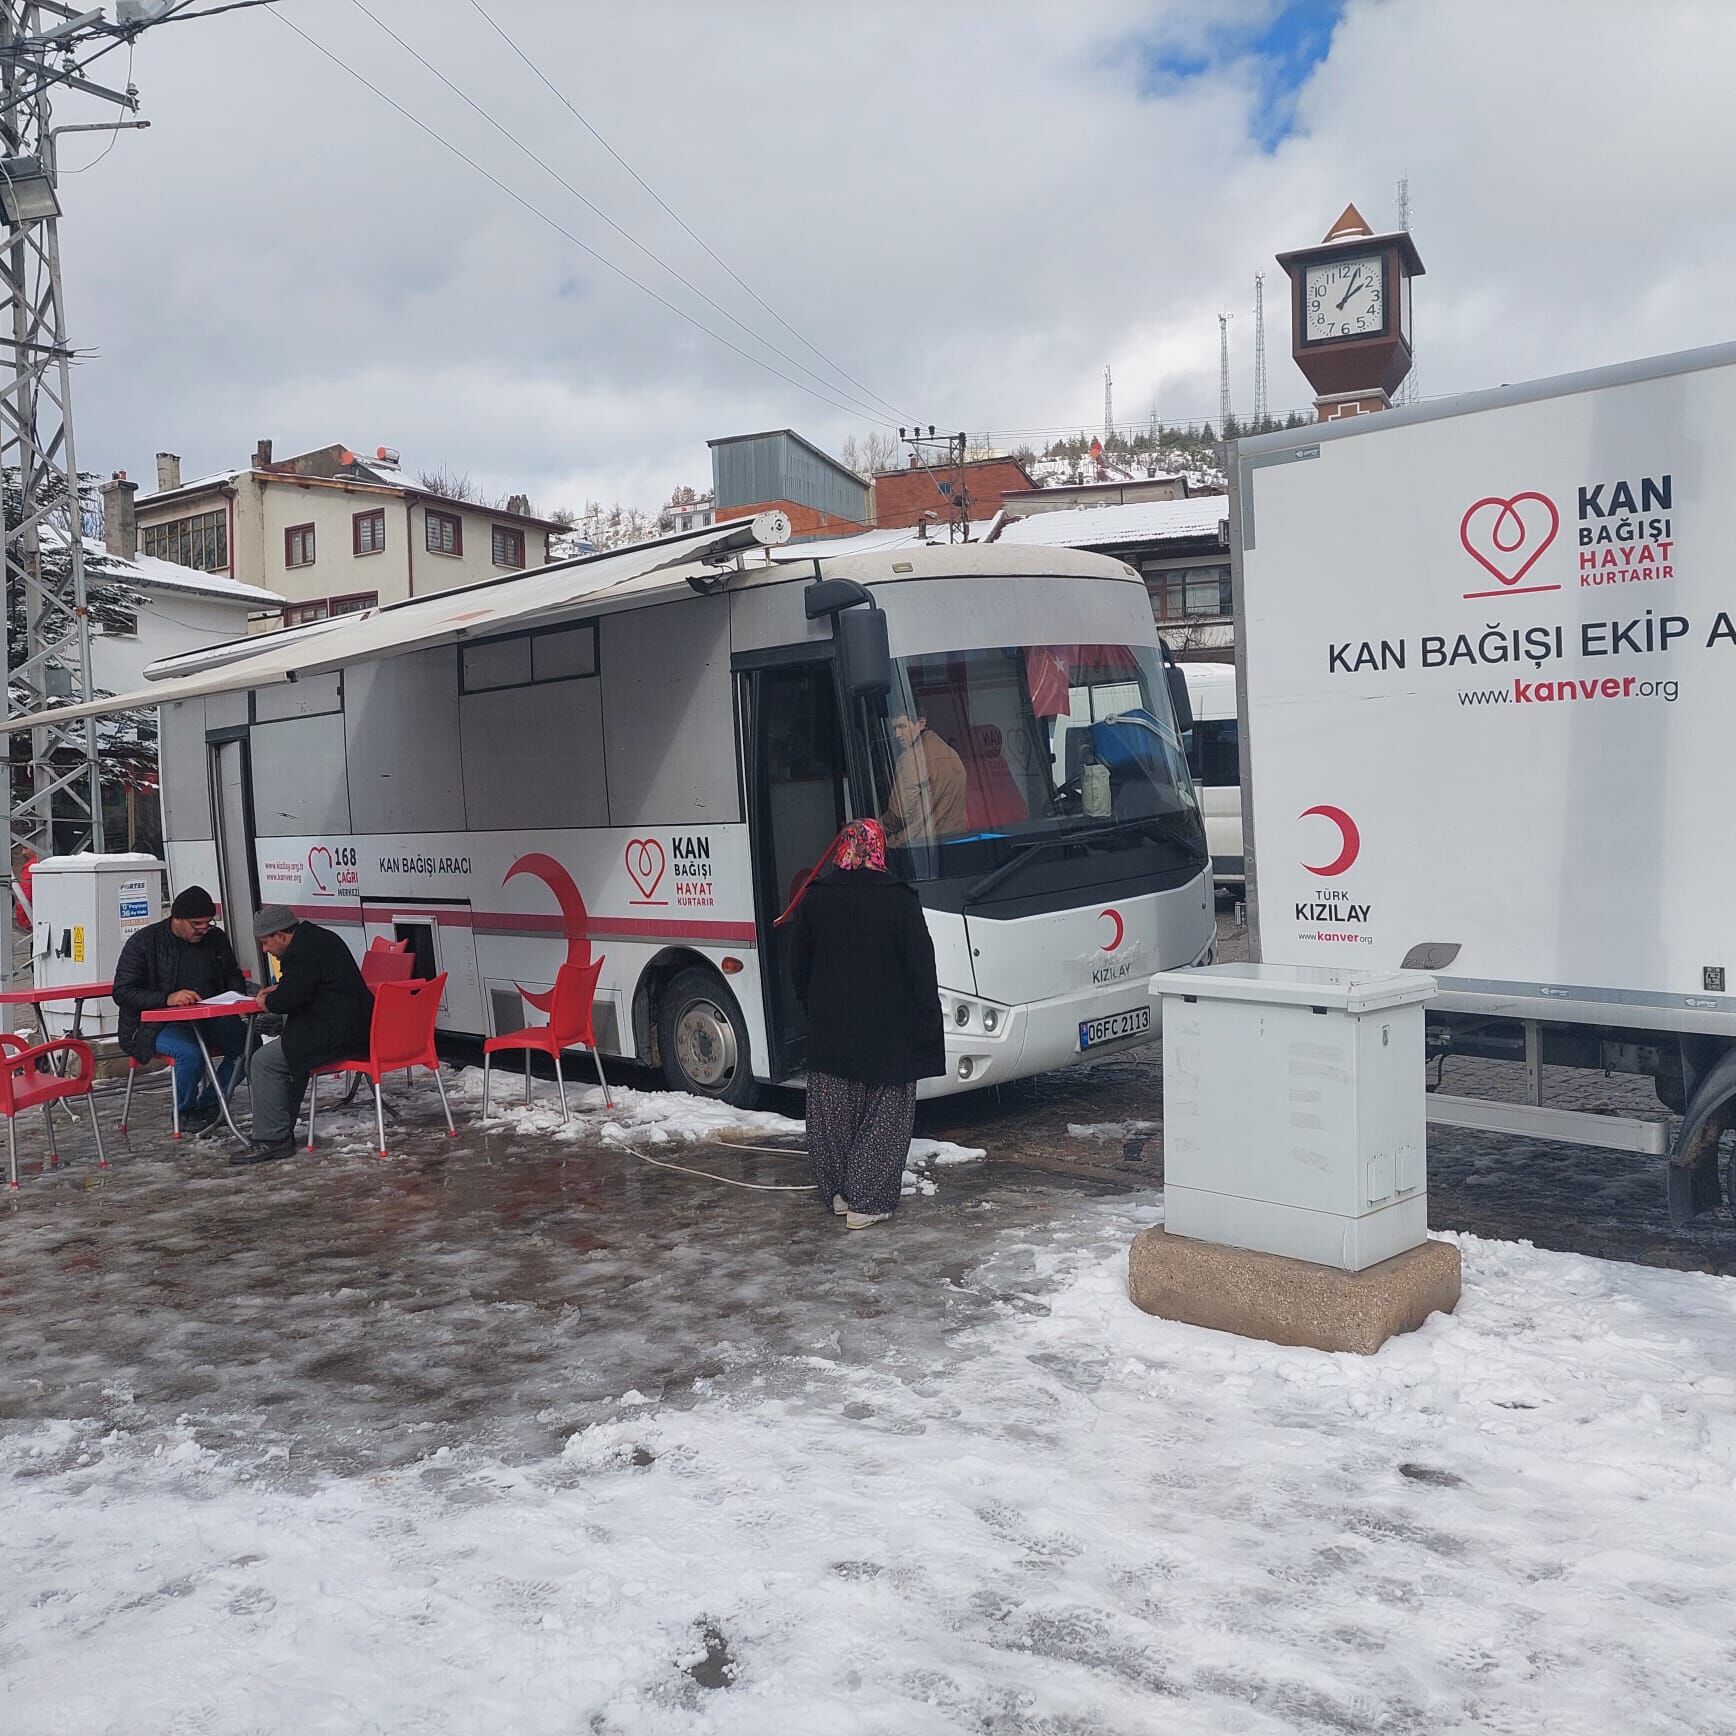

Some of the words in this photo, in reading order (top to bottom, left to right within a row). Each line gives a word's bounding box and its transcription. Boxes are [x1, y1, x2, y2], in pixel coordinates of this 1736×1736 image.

[1326, 272, 1335, 285] 11
[1339, 266, 1351, 279] 12
[1365, 276, 1374, 288] 2
[1314, 285, 1327, 298] 10
[1371, 290, 1380, 302] 3
[1311, 300, 1321, 312] 9
[1366, 304, 1376, 315] 4
[1317, 313, 1326, 324] 8
[1356, 316, 1366, 329] 5
[1327, 322, 1336, 334] 7
[1341, 323, 1351, 335] 6
[1578, 475, 1673, 520] KAN
[1578, 517, 1672, 546] BAĞIŞI
[1579, 542, 1675, 570] HAYAT
[1580, 565, 1675, 587] KURTARIR
[1329, 638, 1406, 673] KAN
[1421, 621, 1564, 669] BAĞIŞI
[1581, 609, 1690, 657] EKİP
[1457, 676, 1679, 706] www.kanver.org
[672, 837, 710, 859] KAN
[335, 848, 357, 866] 168
[379, 858, 400, 872] KAN
[402, 854, 436, 877] BAĞIŞI
[438, 858, 472, 874] ARACI
[674, 861, 712, 879] BAĞIŞI
[336, 869, 359, 886] ÇAĞRI
[676, 882, 712, 895] HAYAT
[1315, 888, 1349, 901] TÜRK
[677, 898, 714, 906] KURTARIR
[1295, 903, 1371, 922] KIZILAY
[1092, 963, 1131, 984] KIZILAY
[1121, 1011, 1149, 1033] 2113
